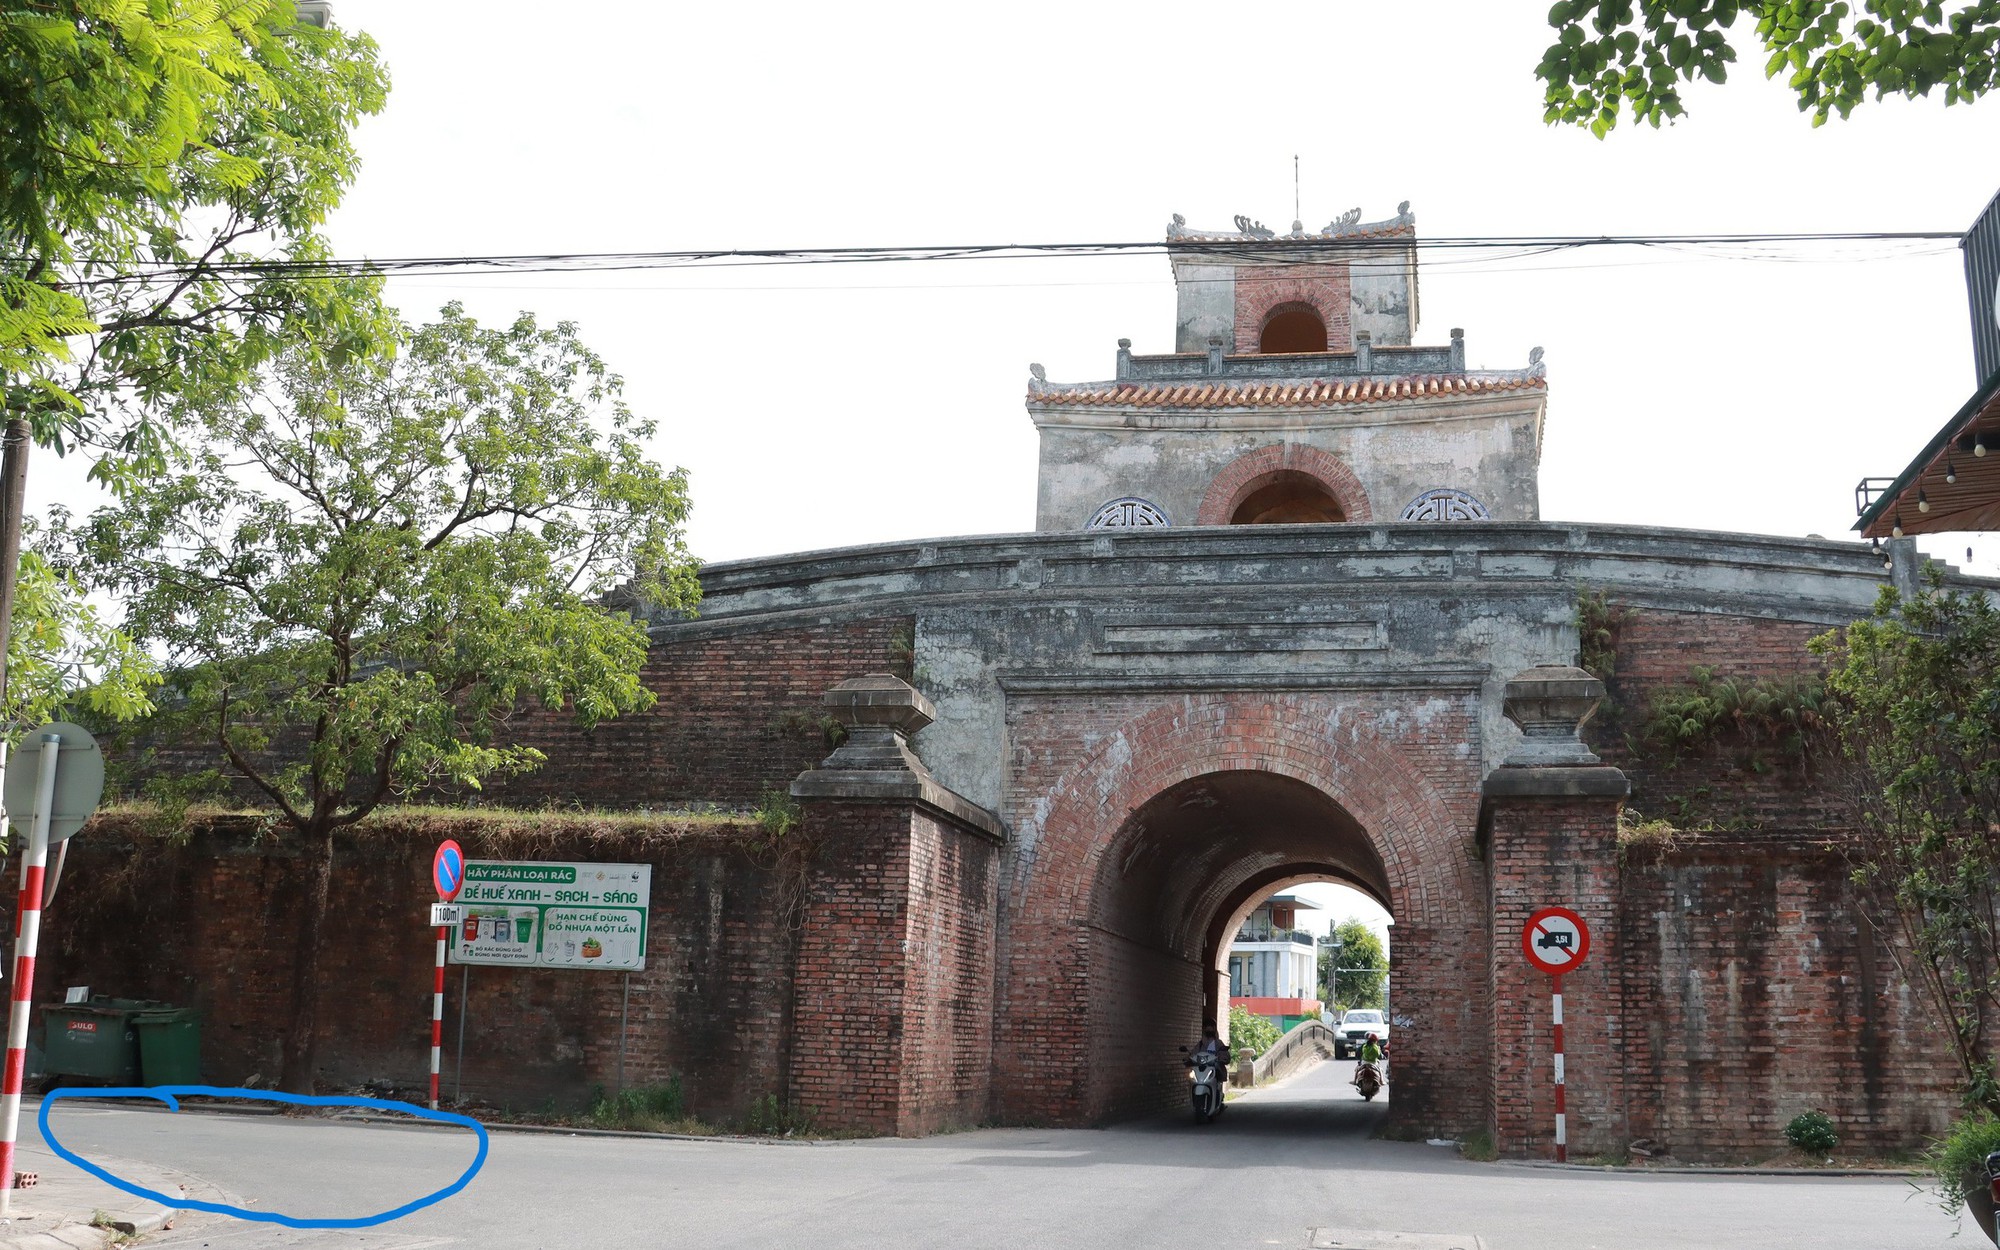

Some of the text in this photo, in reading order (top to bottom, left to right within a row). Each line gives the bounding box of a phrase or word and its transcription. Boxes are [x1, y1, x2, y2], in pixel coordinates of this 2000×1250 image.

[467, 868, 489, 877] HÃY
[491, 868, 520, 878] PHÂN
[523, 870, 548, 881] LOẠI
[550, 869, 573, 880] RÁC
[464, 883, 481, 899] ĐỂ
[481, 884, 507, 899] HUẾ
[507, 889, 541, 900] XANH
[554, 890, 589, 904] SẠCH
[603, 889, 638, 903] SÁNG
[439, 907, 457, 921] 100m
[556, 912, 628, 922] HẠN CHẾ DÙNG
[594, 924, 616, 934] MỘT
[71, 1021, 93, 1030] SULO
